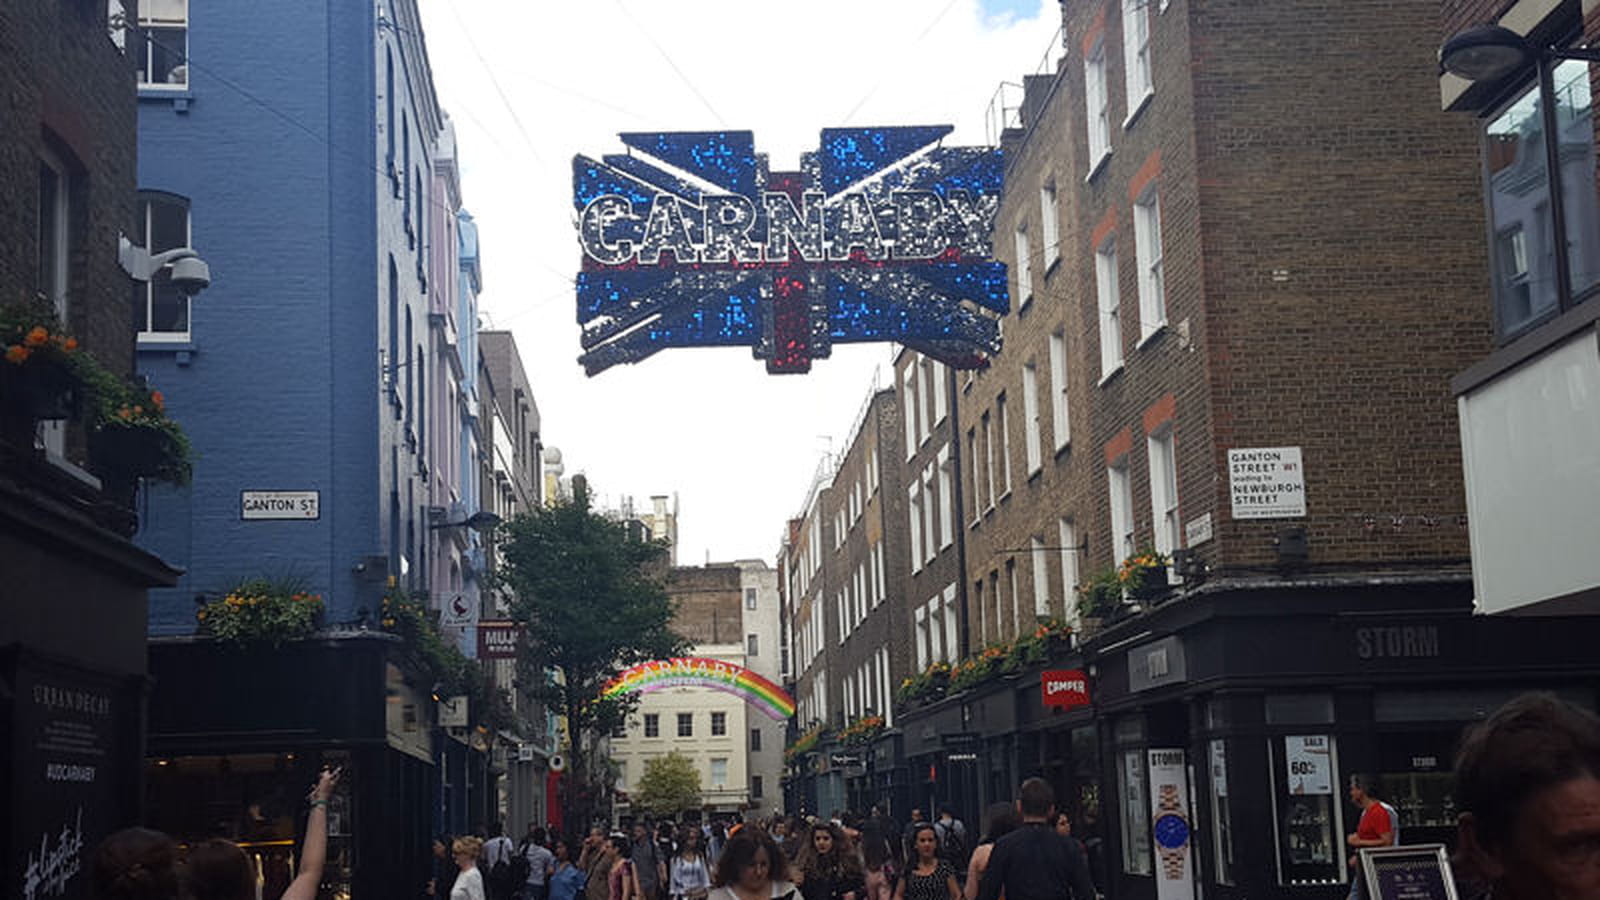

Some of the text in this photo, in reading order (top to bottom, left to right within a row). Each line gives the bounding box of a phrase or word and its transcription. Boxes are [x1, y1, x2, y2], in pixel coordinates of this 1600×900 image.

[579, 191, 1001, 265] CARNABY
[1231, 453, 1281, 462] GANTON
[1233, 463, 1275, 473] STREET
[1233, 483, 1302, 494] NEWBURGH
[243, 499, 295, 511] GANTON
[1234, 494, 1278, 504] STREET
[1356, 625, 1439, 658] STORM
[623, 659, 745, 688] CARNABY
[1047, 680, 1085, 695] CAMPER
[1151, 751, 1183, 766] STORM
